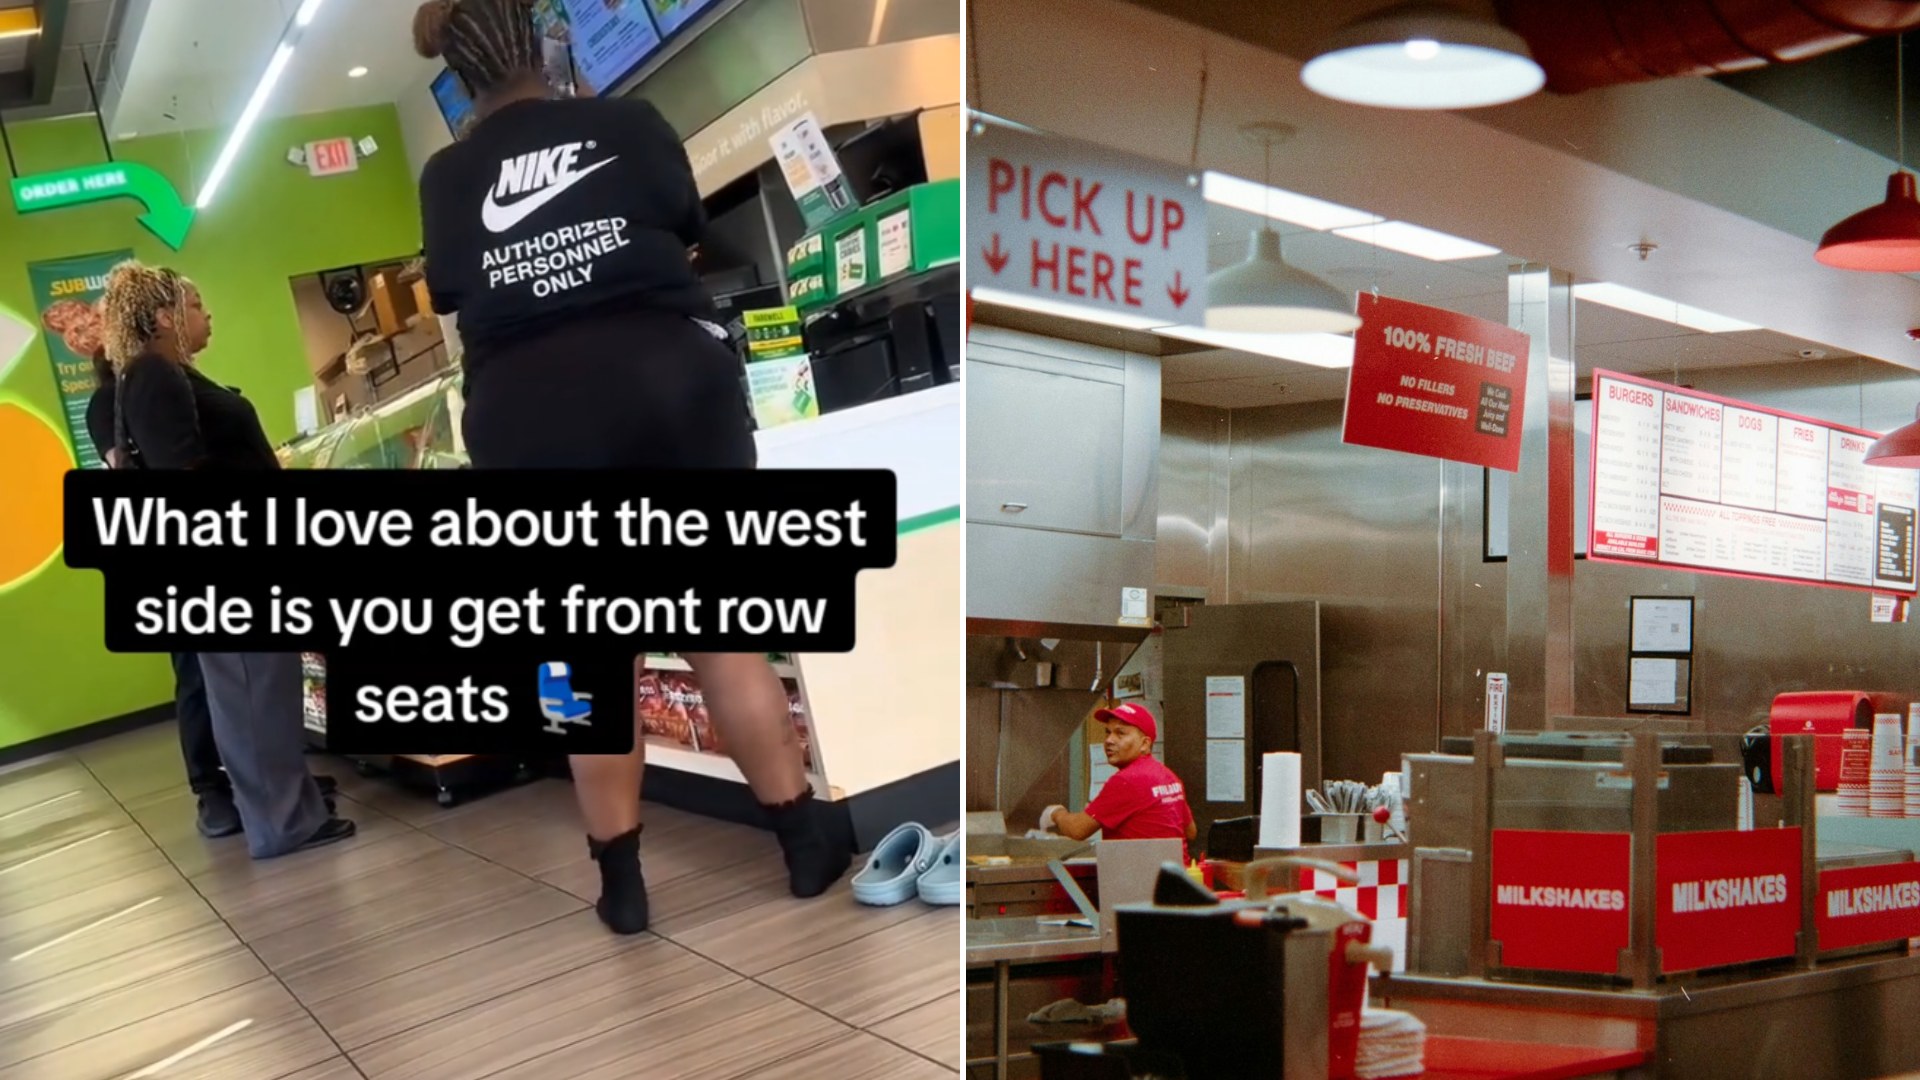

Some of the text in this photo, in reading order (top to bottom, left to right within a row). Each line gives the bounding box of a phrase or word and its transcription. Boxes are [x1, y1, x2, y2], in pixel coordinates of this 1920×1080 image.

[314, 140, 349, 171] EXIT
[495, 141, 584, 198] NIKE
[19, 169, 128, 202] ORDER HERE
[987, 156, 1185, 250] PICK UP
[481, 216, 628, 270] AUTHORIZED
[488, 231, 631, 289] PERSONNEL
[1030, 237, 1143, 308] HERE
[532, 262, 594, 298] ONLY
[1383, 325, 1517, 374] 100% FRESH BEEF
[1400, 374, 1456, 397] NO FILLERS
[1609, 385, 1654, 408] BURGERS
[1376, 392, 1469, 420] NO PRESERVATIVES
[1665, 397, 1721, 422] SANDWICHES
[1738, 415, 1763, 431] DOGS
[1793, 427, 1815, 442] FRIES
[1840, 437, 1866, 453] DRINKS
[1497, 884, 1625, 911] MILKSHAKES
[1672, 873, 1787, 914] MILKSHAKES
[1826, 881, 1920, 918] MILKSHAKES
